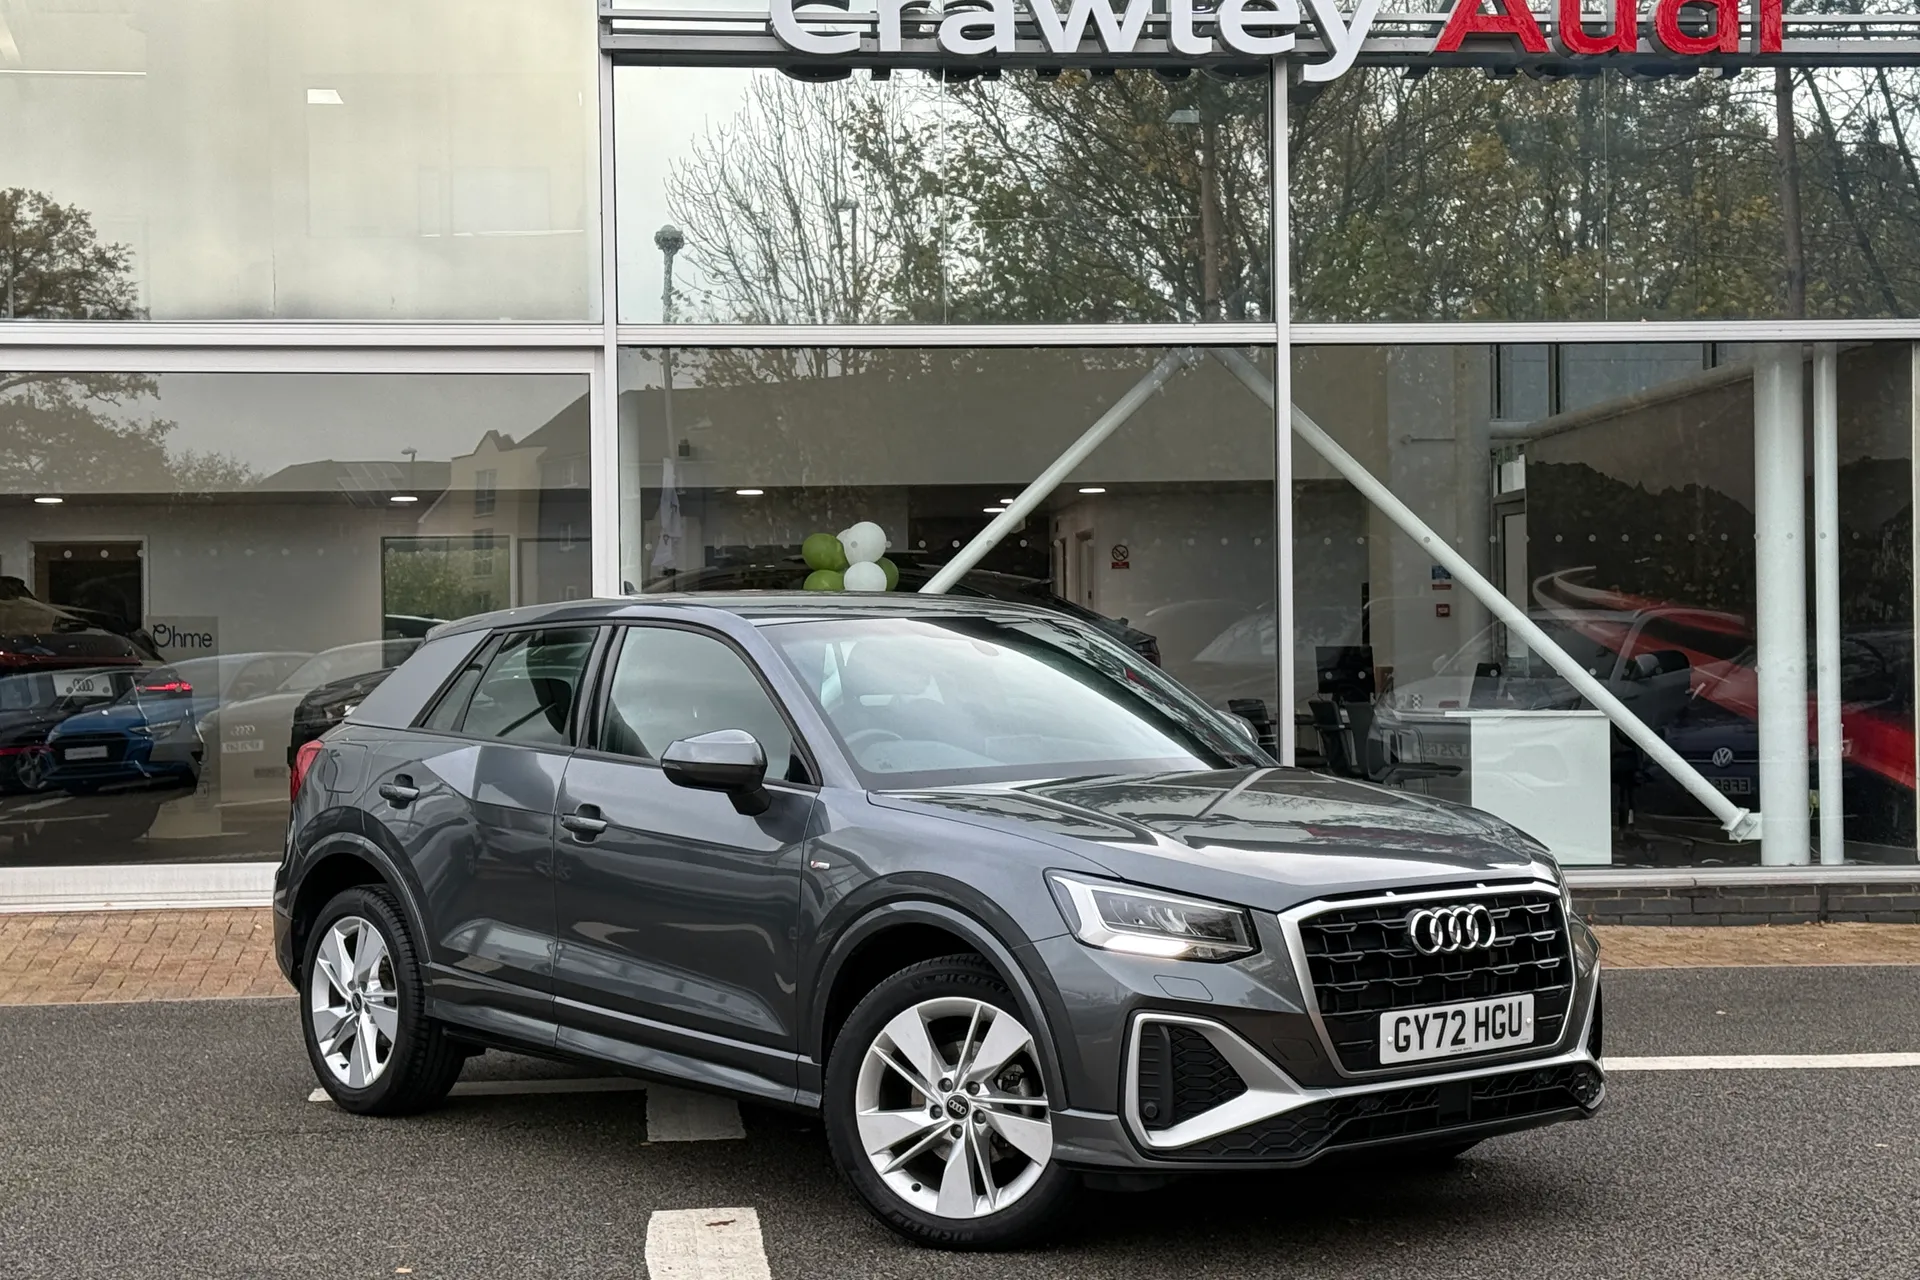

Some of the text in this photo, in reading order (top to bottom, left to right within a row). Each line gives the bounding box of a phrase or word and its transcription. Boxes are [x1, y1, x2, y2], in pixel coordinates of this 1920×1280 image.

[153, 623, 213, 648] Ohme
[1394, 1001, 1523, 1053] GY72 HGU
